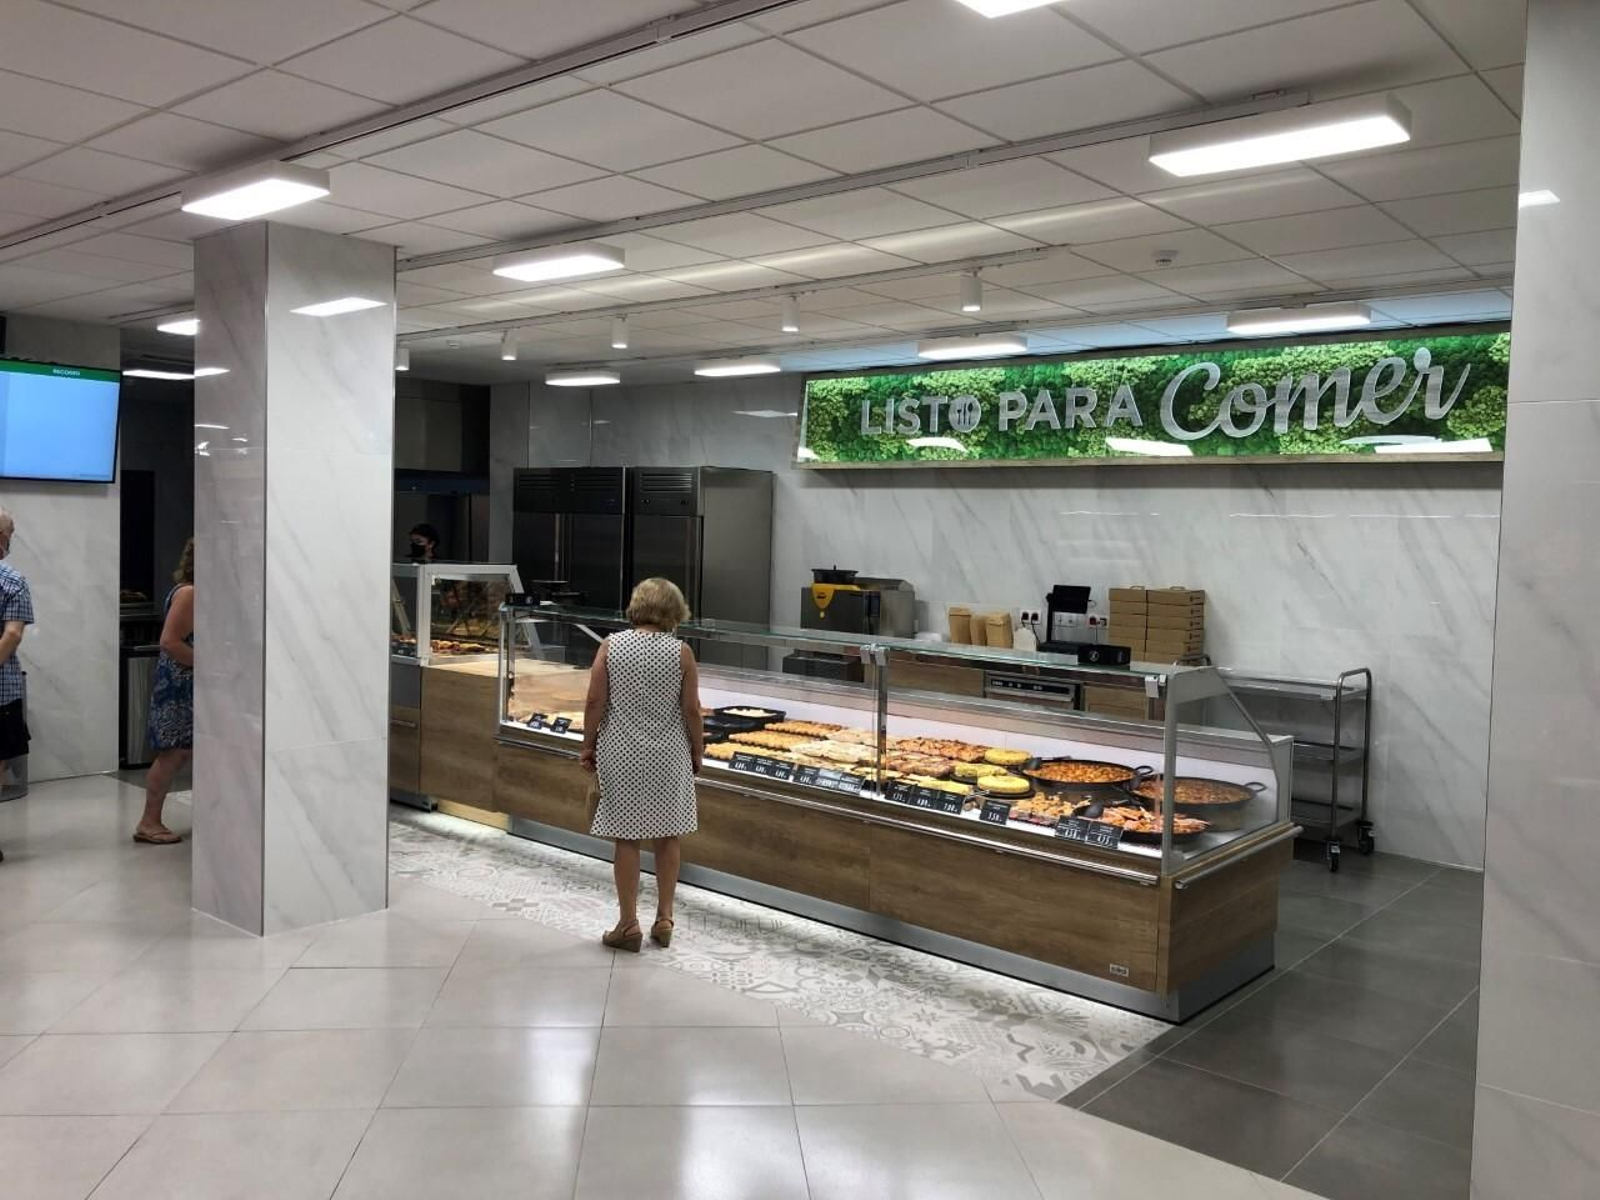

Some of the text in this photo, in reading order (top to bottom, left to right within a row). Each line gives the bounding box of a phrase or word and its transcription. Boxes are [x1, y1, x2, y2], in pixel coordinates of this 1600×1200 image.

[860, 346, 1471, 441] LISTO PARA Comer
